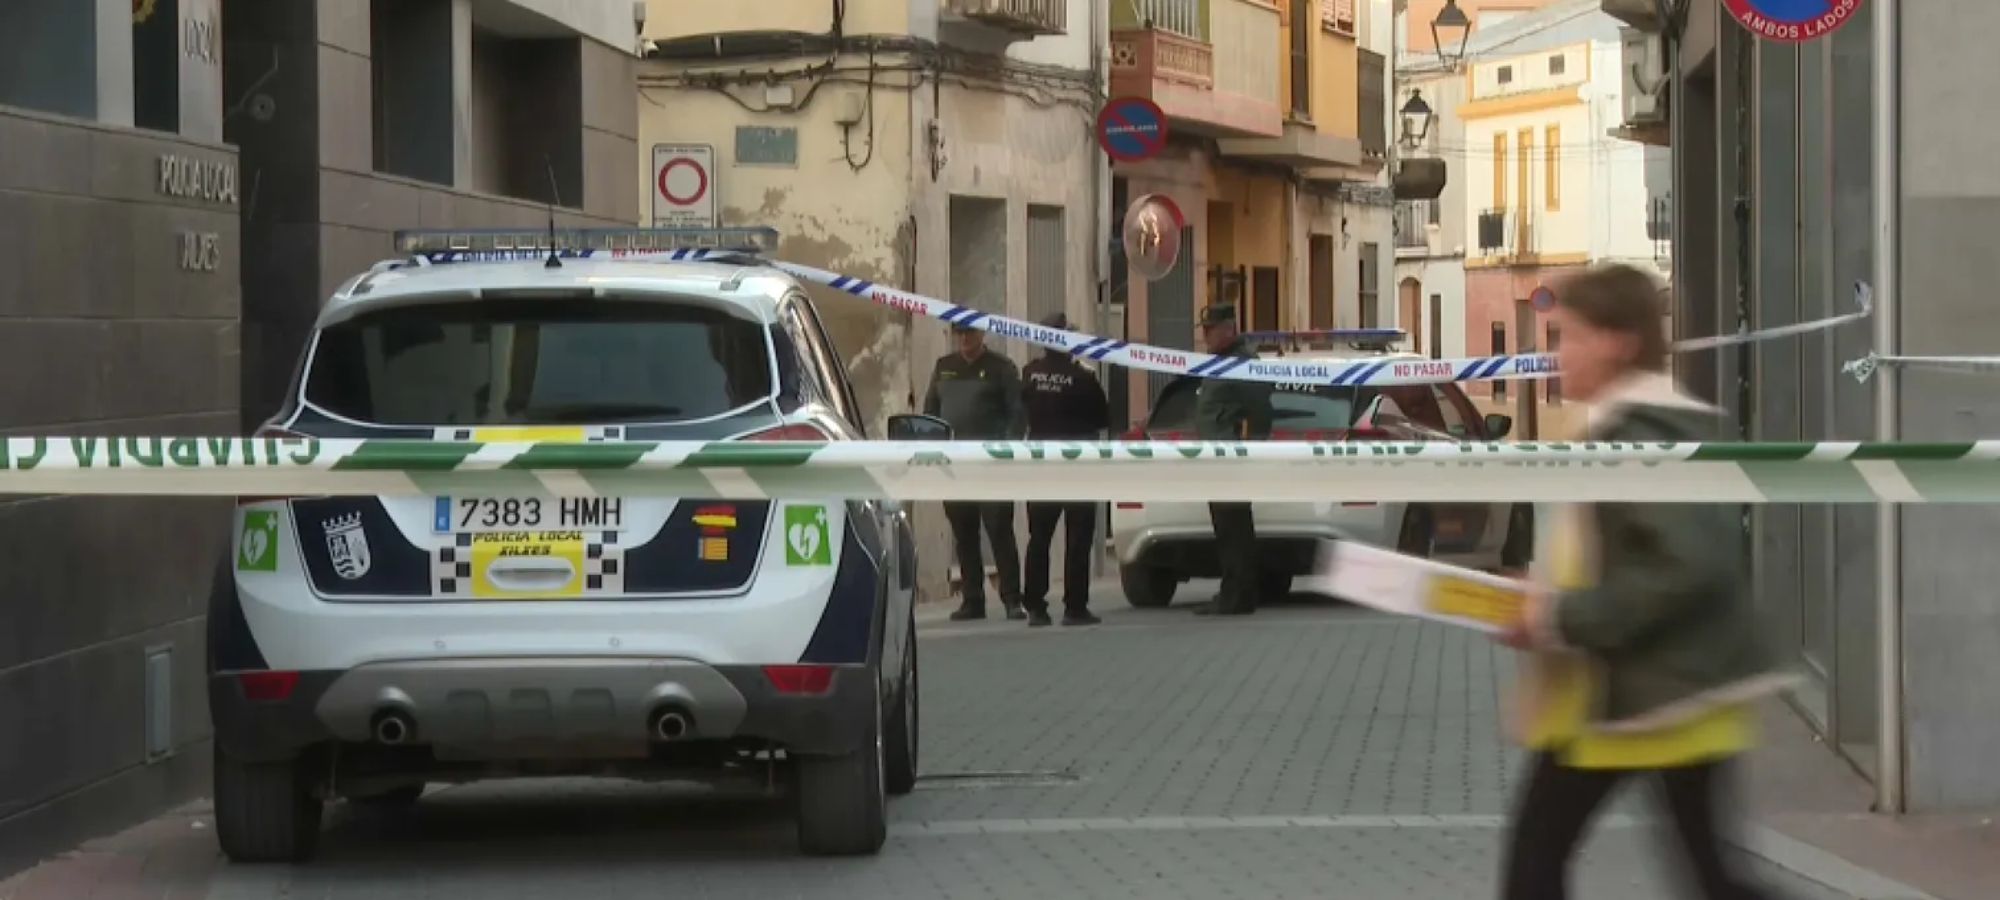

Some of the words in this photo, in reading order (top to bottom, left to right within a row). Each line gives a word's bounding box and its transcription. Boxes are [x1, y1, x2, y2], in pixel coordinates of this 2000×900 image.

[1742, 11, 1799, 38] AMBOS
[1805, 0, 1854, 36] LADOS
[988, 318, 1032, 339] POLICIA
[1034, 327, 1068, 346] LOCAL
[1129, 349, 1146, 360] NO
[1149, 352, 1187, 367] PASAR
[1248, 364, 1292, 377] POLICIA
[1295, 366, 1329, 378] LOCAL
[1393, 364, 1409, 378] NO
[1413, 362, 1453, 377] PASAR
[1031, 373, 1072, 385] POLICIA
[460, 497, 541, 527] 7383
[560, 497, 622, 526] HMH
[473, 531, 530, 543] POLICIA
[539, 531, 583, 541] LOCAL
